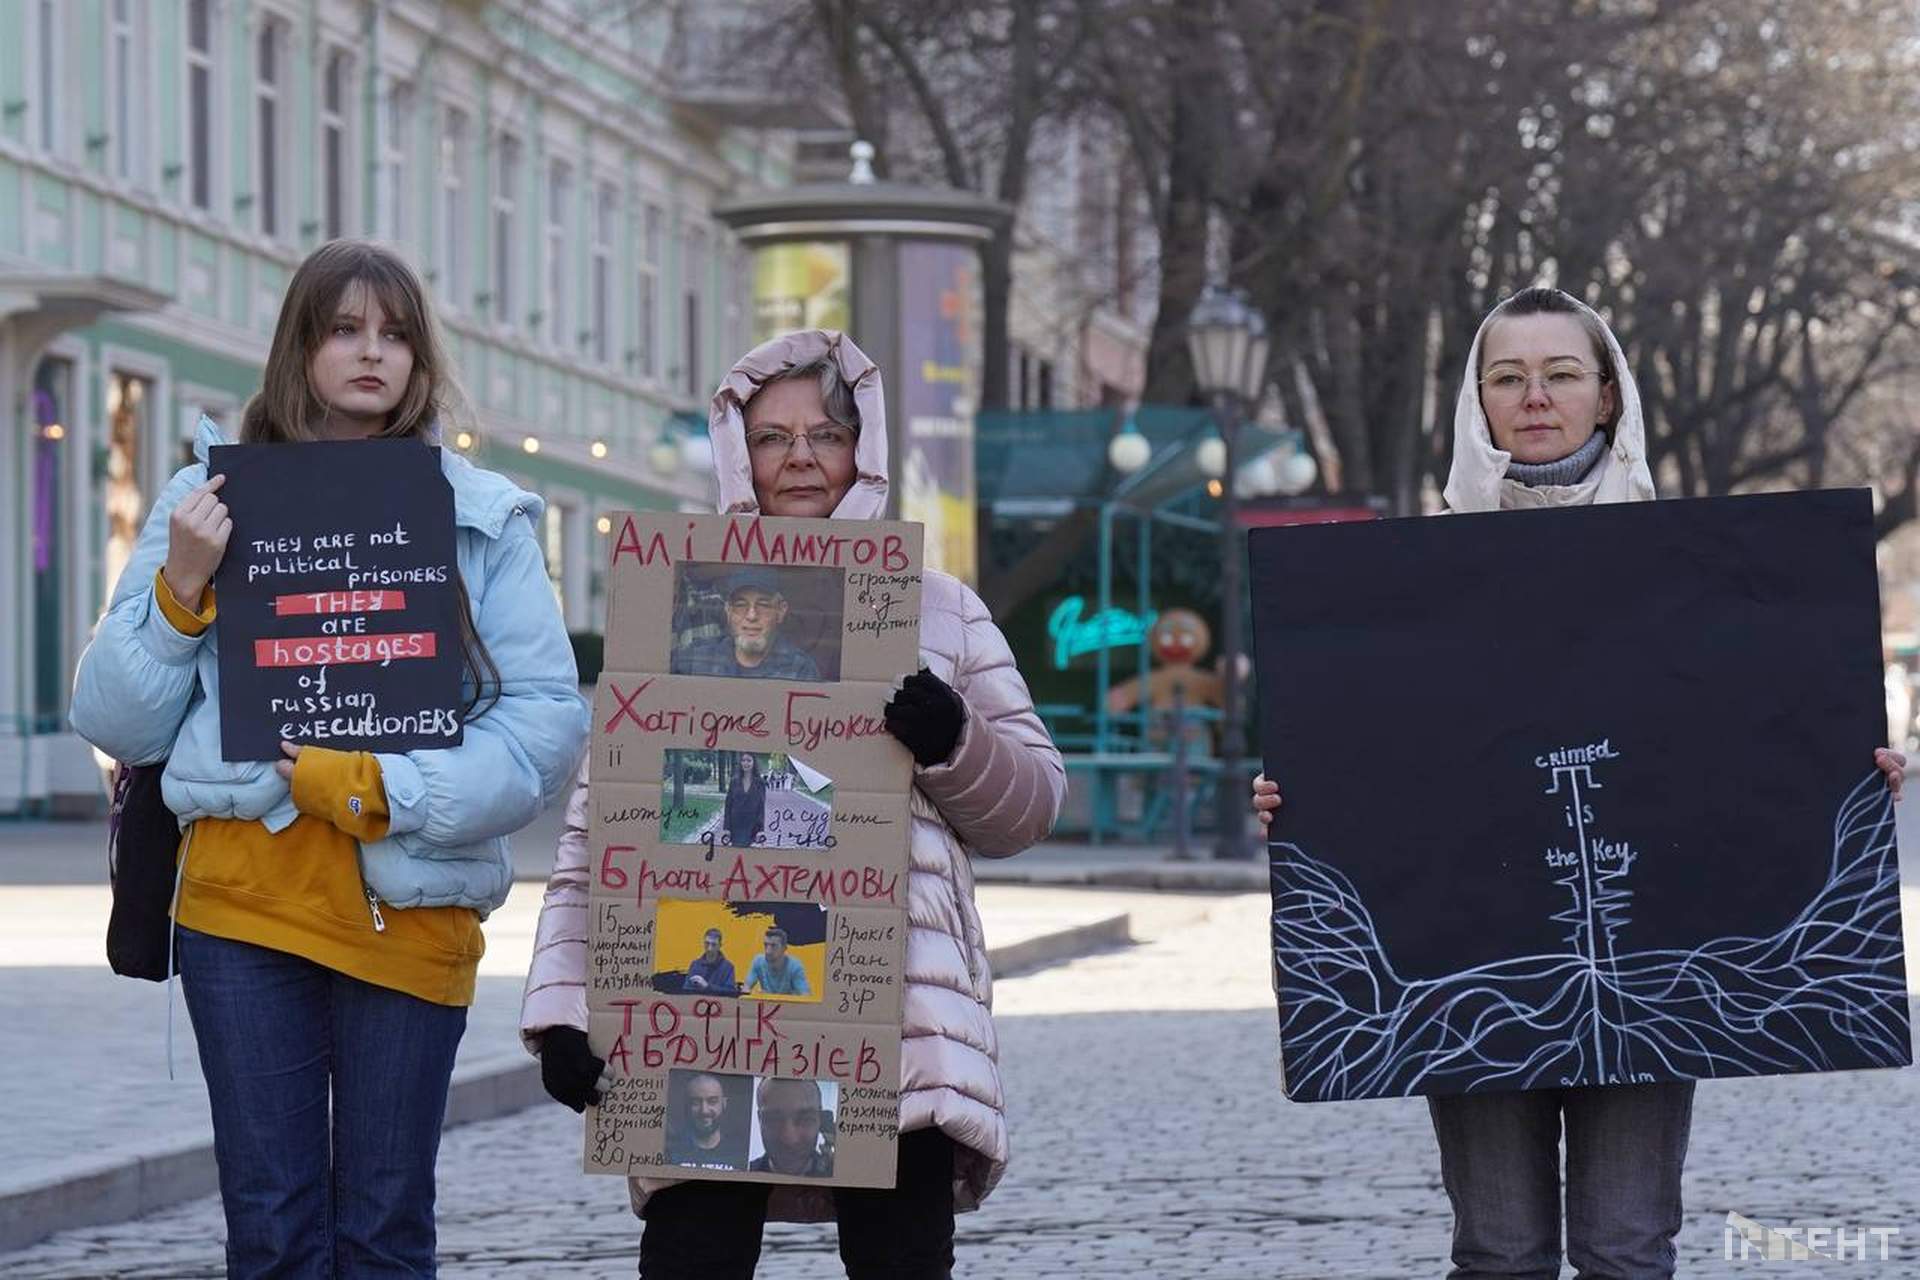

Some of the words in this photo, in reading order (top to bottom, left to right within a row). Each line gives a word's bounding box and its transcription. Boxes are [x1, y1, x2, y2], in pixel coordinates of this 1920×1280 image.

[251, 536, 302, 553] THEY
[370, 522, 411, 546] not
[612, 516, 696, 567] Алі
[721, 517, 909, 572] Мамутов
[306, 590, 384, 613] THEY
[299, 665, 327, 694] of
[271, 692, 376, 713] russian
[604, 677, 770, 748] Хатідже
[607, 744, 624, 767] її
[1565, 805, 1594, 827] is
[1546, 848, 1579, 867] the
[600, 847, 713, 909] Брати
[598, 903, 621, 933] 15
[830, 946, 889, 967] Асан
[607, 998, 787, 1040] ТОФІК
[608, 1034, 882, 1084] АБДУЛГАЗІЄВ
